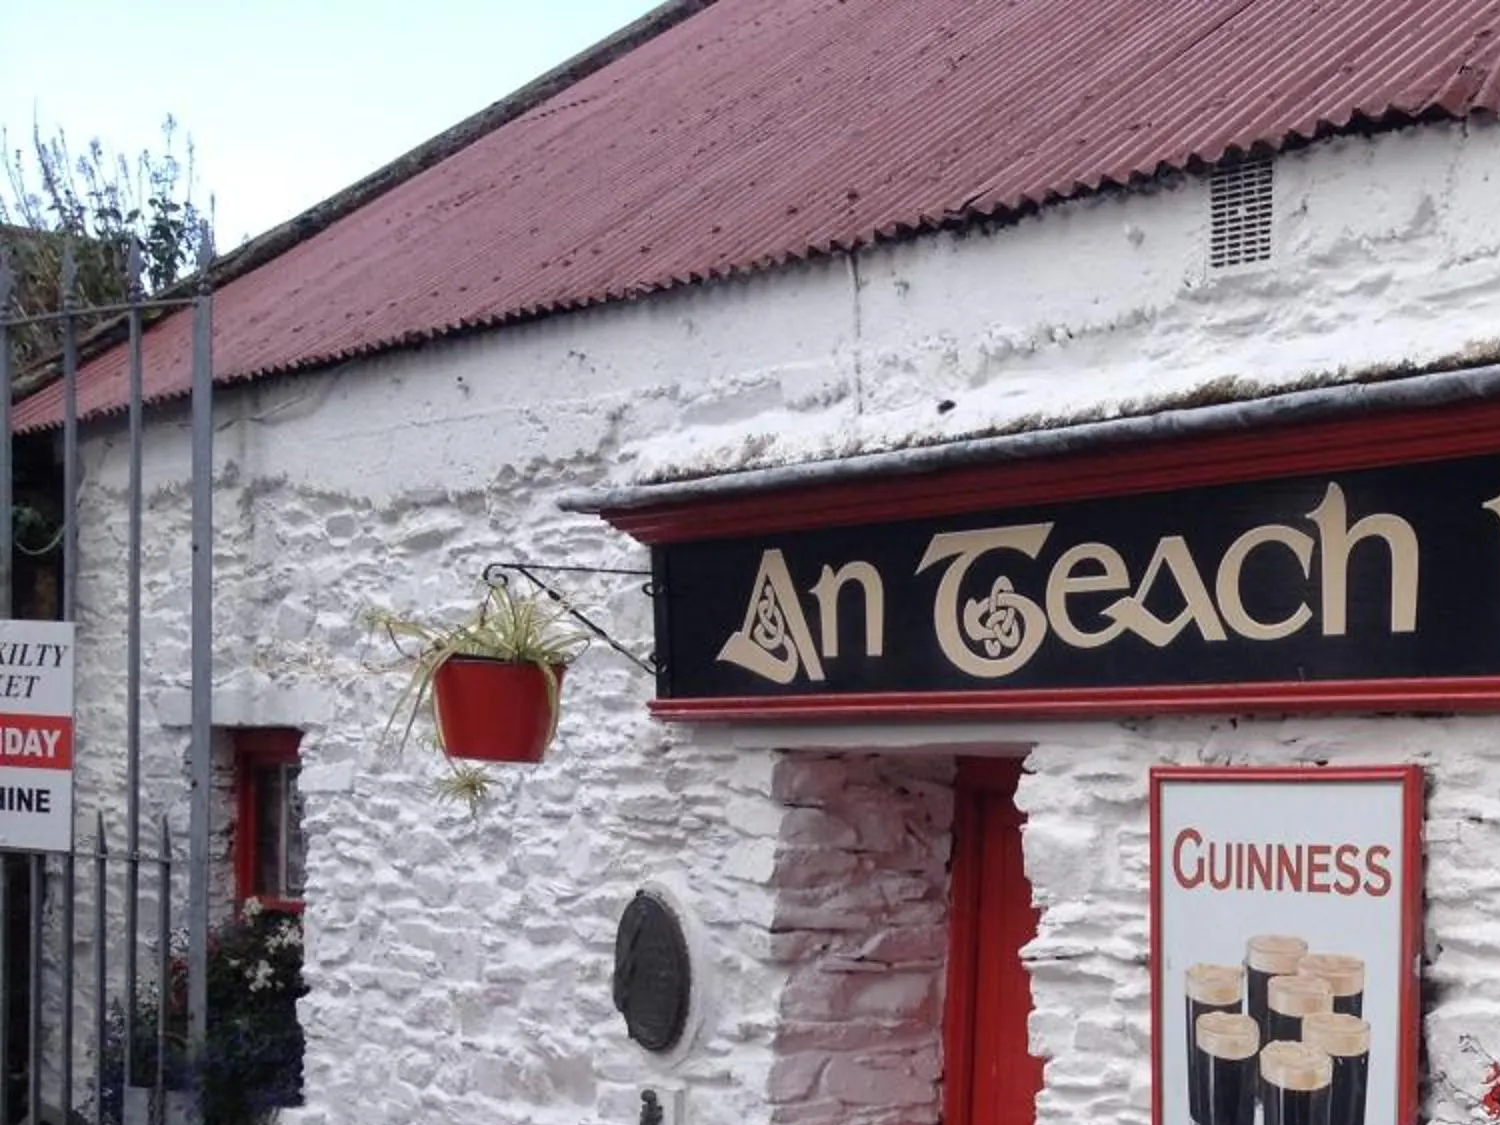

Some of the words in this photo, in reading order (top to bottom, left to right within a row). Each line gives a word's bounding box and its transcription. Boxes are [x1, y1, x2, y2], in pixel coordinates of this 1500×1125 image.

[716, 549, 884, 684] An
[915, 481, 1419, 679] Teach
[0, 674, 40, 698] ET
[0, 727, 62, 758] DAY
[1172, 827, 1393, 897] GUINNESS
